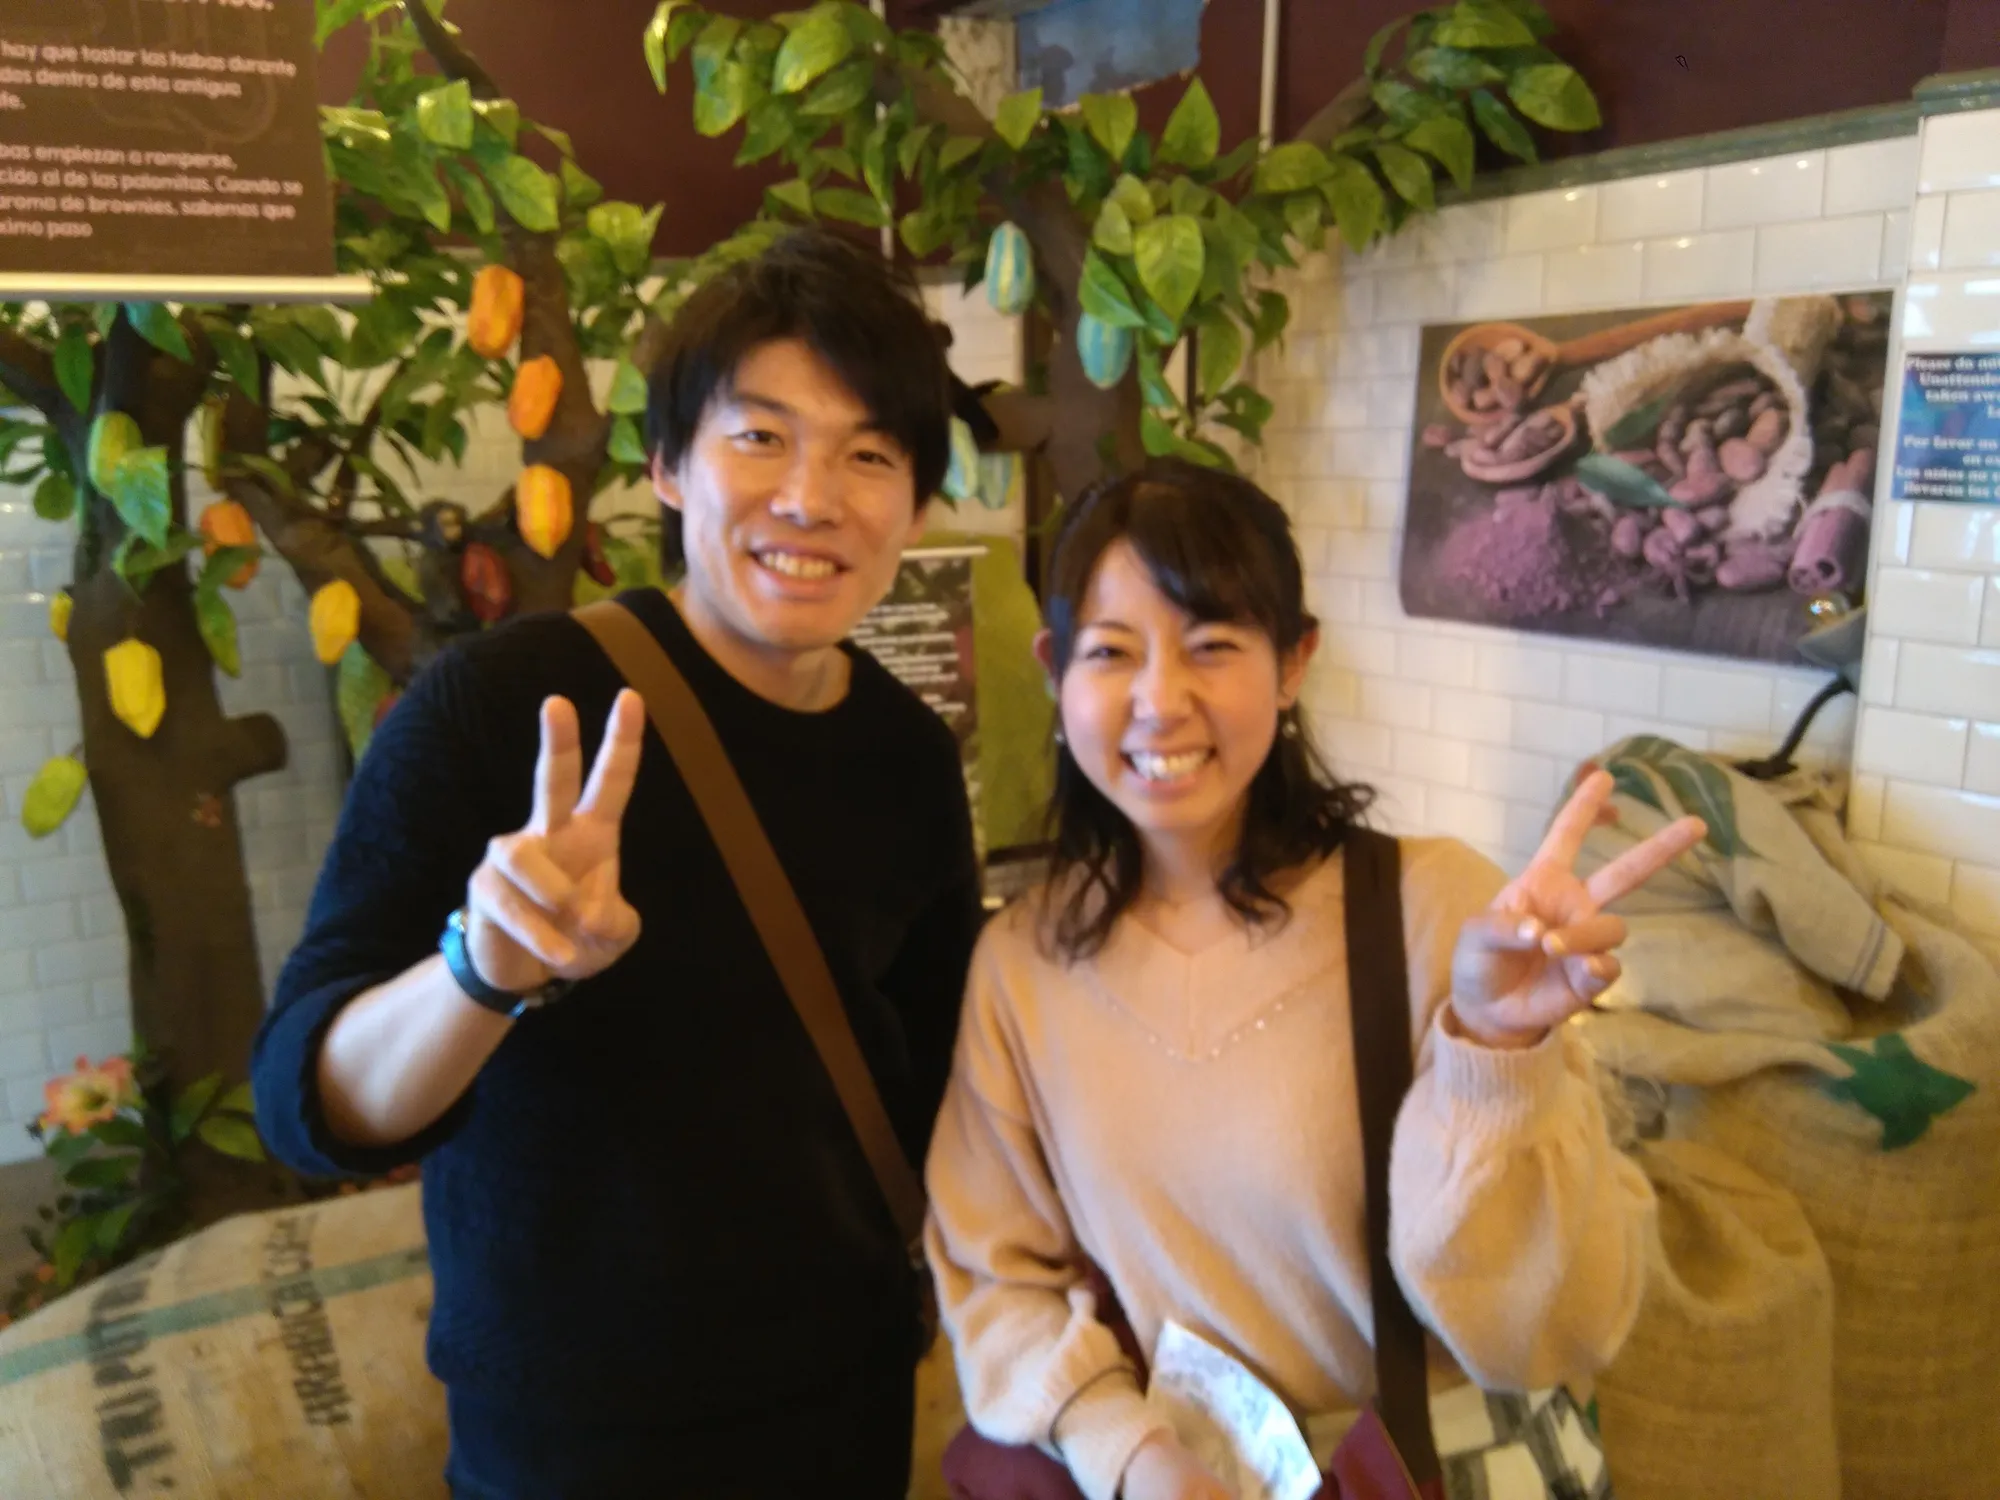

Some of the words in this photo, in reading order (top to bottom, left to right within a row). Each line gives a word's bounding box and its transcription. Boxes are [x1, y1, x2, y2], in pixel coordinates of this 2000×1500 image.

[41, 46, 78, 65] que
[81, 45, 137, 68] tostar
[169, 50, 226, 72] habas
[228, 57, 296, 78] durante
[36, 70, 98, 88] dentro
[101, 73, 127, 91] de
[129, 75, 170, 92] esta
[172, 78, 242, 99] antigua
[34, 146, 125, 166] empiezan
[128, 151, 142, 166] a
[42, 168, 60, 187] al
[63, 170, 88, 188] de
[215, 176, 281, 195] Cuando
[283, 180, 303, 196] se
[59, 194, 85, 212] de
[181, 199, 259, 218] sabemos
[261, 204, 296, 221] que
[46, 221, 93, 240] paso
